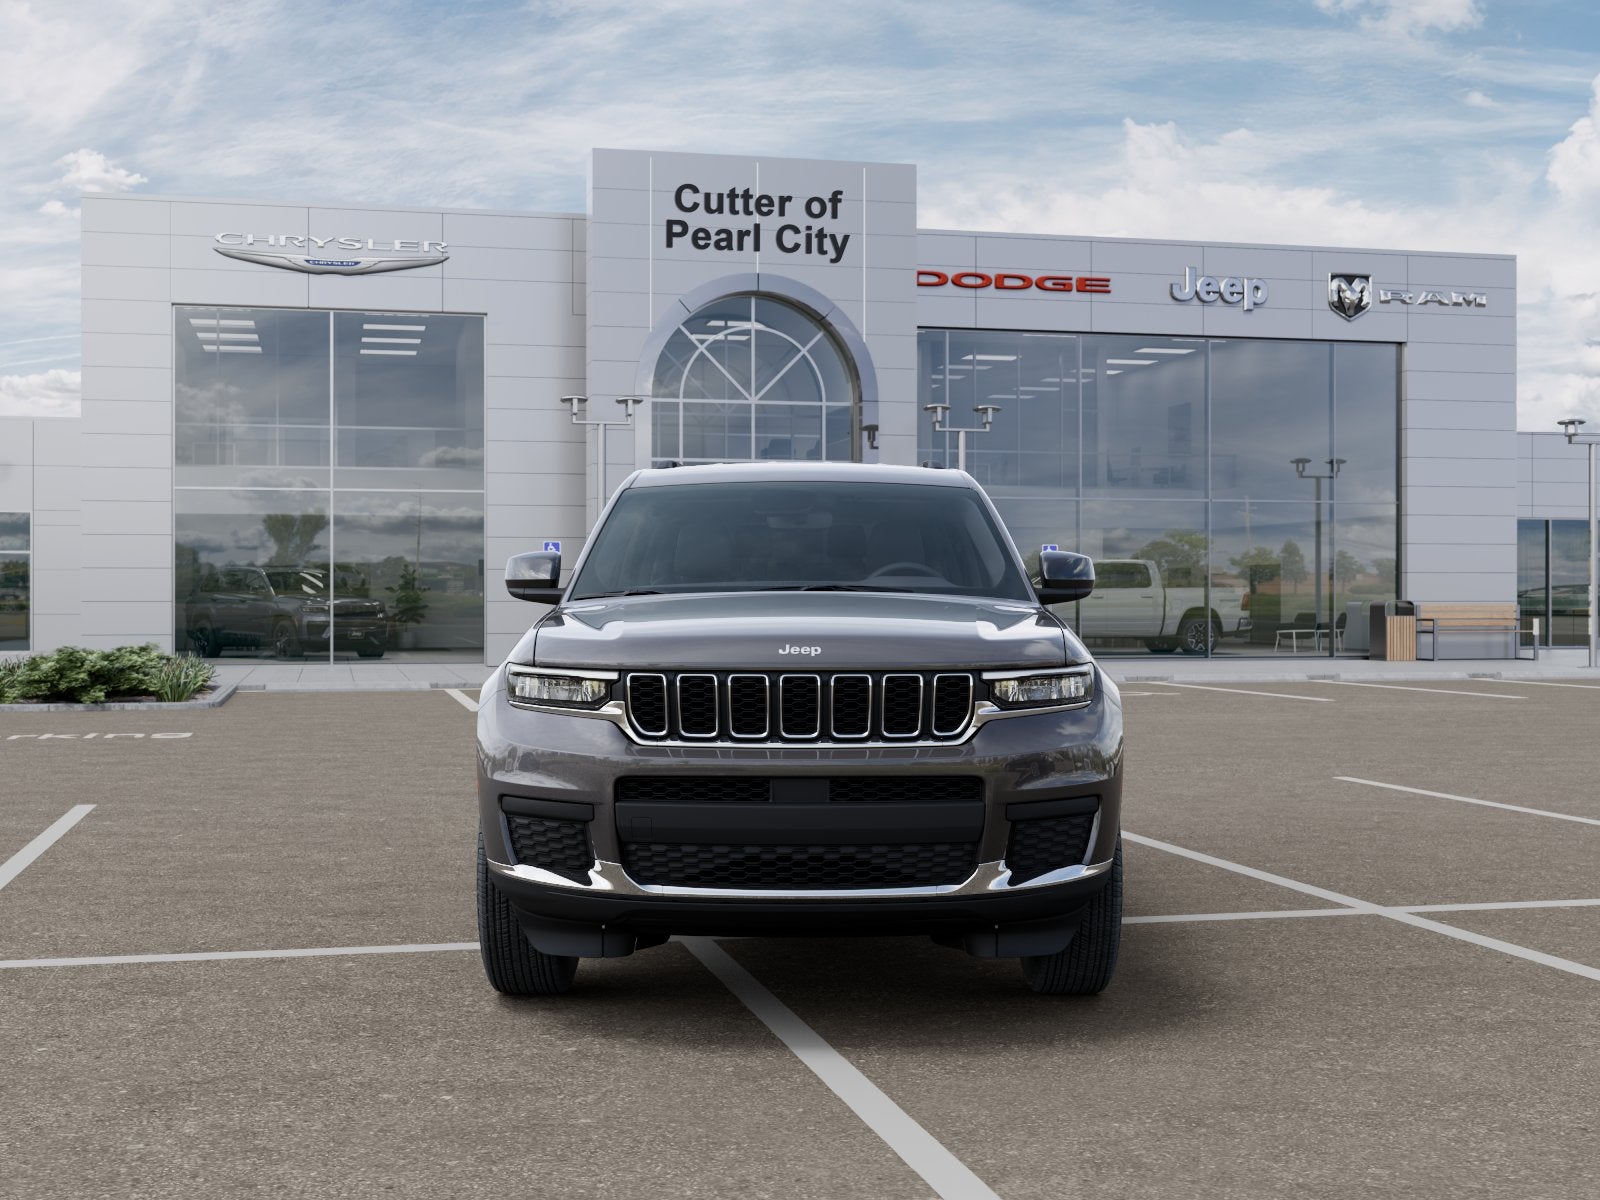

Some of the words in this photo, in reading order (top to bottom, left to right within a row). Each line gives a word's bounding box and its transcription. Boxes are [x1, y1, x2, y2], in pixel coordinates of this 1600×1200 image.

[674, 183, 793, 218] Cutter
[804, 190, 844, 220] of
[214, 232, 449, 253] CHRYSLER
[665, 219, 761, 252] Pearl
[775, 224, 851, 264] City
[916, 270, 1112, 294] DODGE
[1168, 266, 1269, 312] Jeep
[1379, 288, 1487, 308] RAM
[778, 644, 822, 657] Jeep
